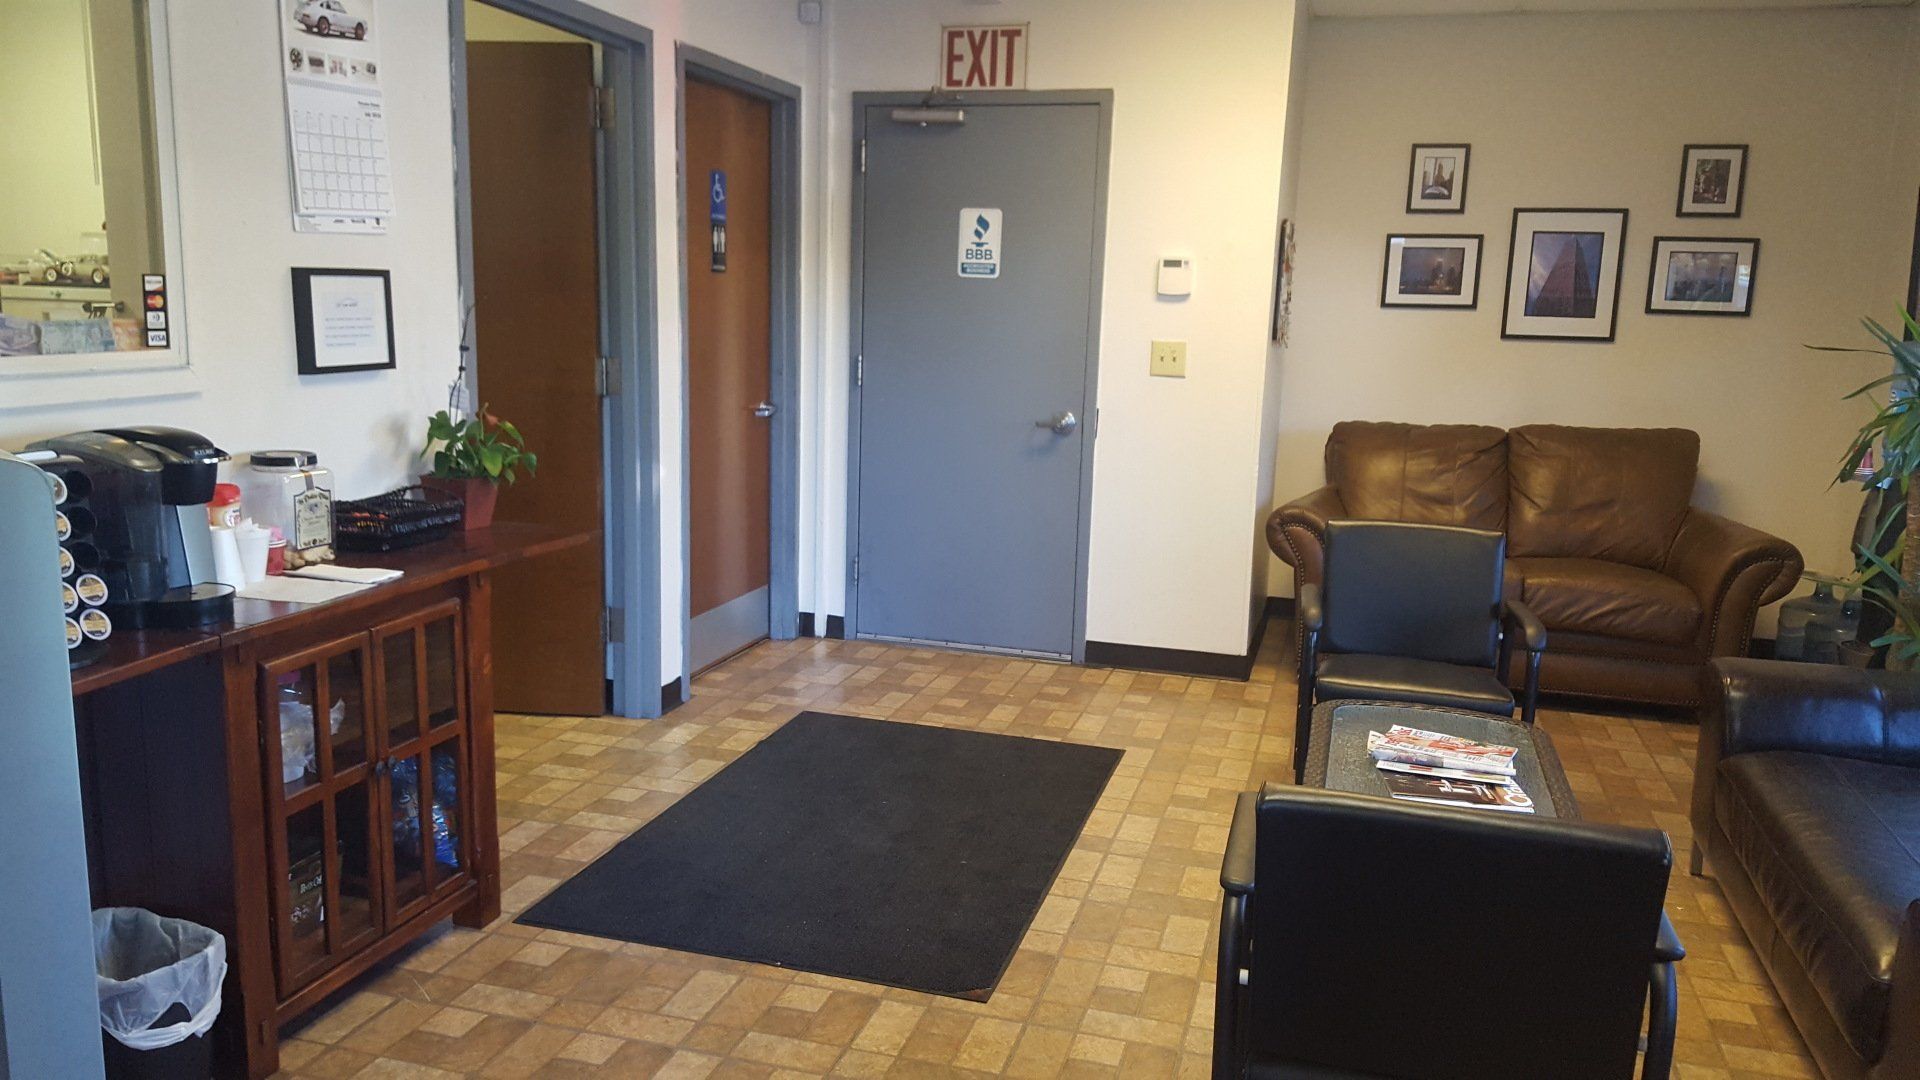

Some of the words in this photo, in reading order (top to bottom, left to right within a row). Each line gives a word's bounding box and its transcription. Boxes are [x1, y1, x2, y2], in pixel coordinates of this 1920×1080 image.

[946, 28, 1022, 87] EXIT
[965, 248, 993, 260] BBB
[150, 334, 166, 342] VISA
